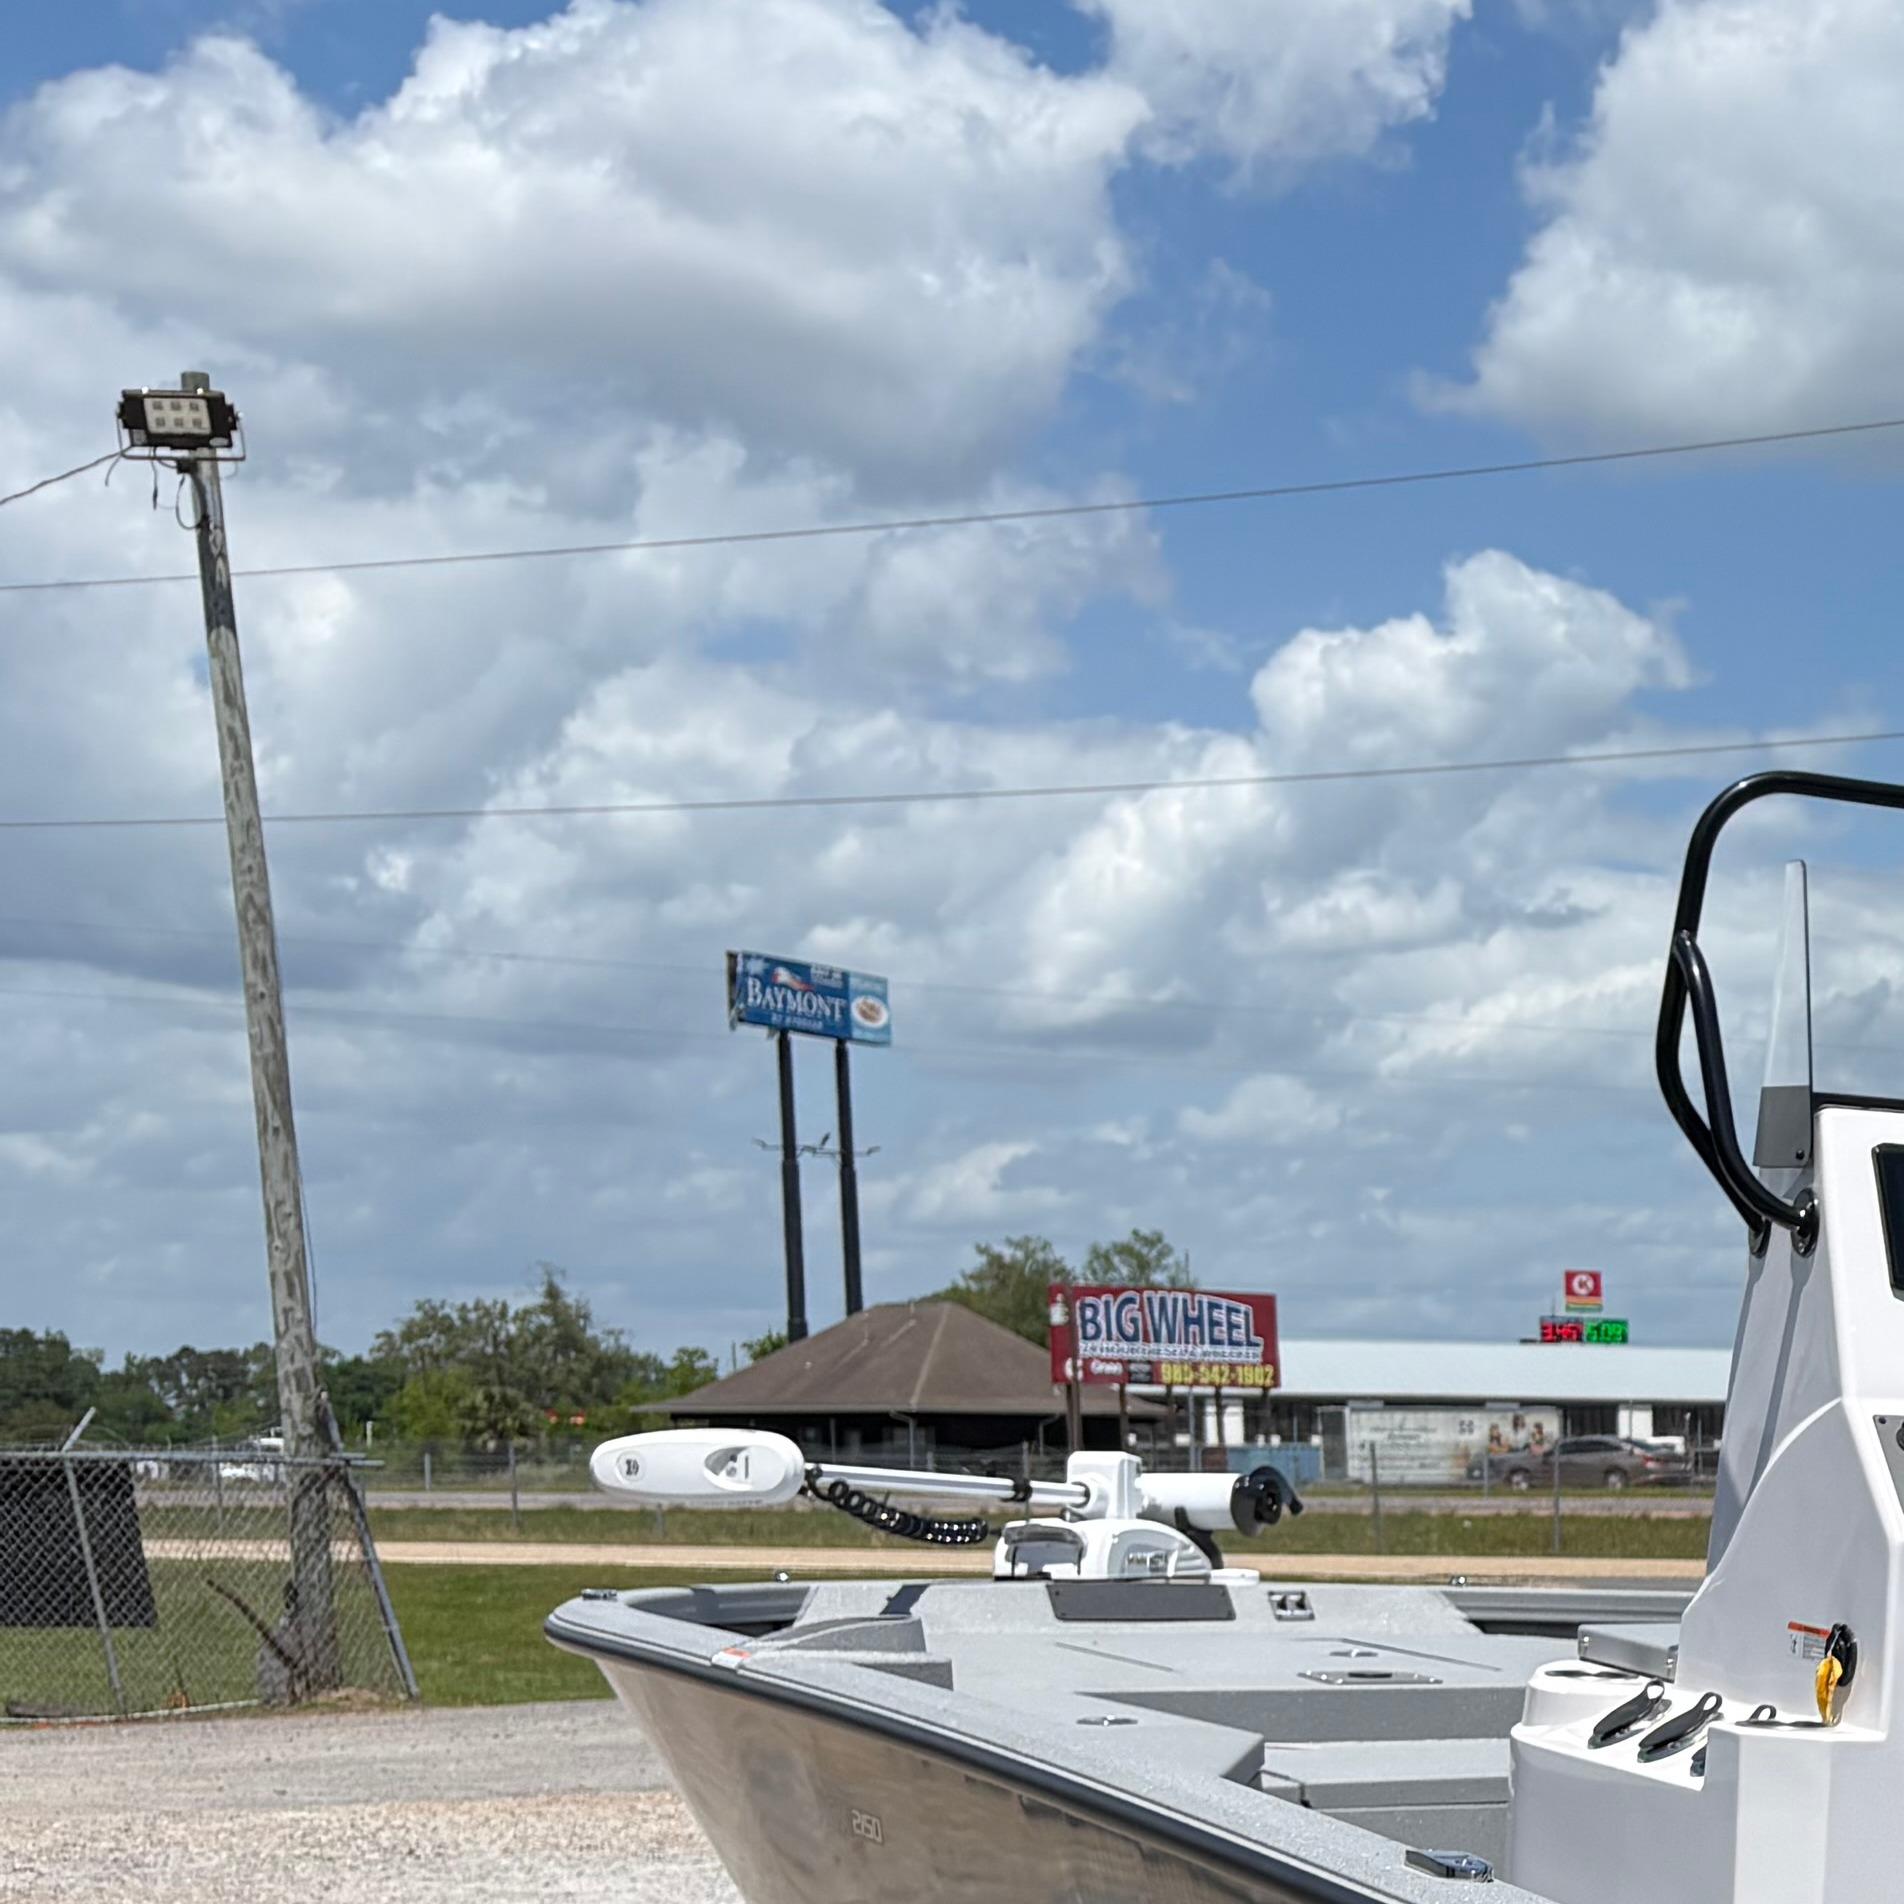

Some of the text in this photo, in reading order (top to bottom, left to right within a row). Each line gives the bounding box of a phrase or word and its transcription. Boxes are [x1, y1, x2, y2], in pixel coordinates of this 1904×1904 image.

[747, 976, 846, 1022] BAYMONT
[1077, 1291, 1264, 1349] BIG WHEEL
